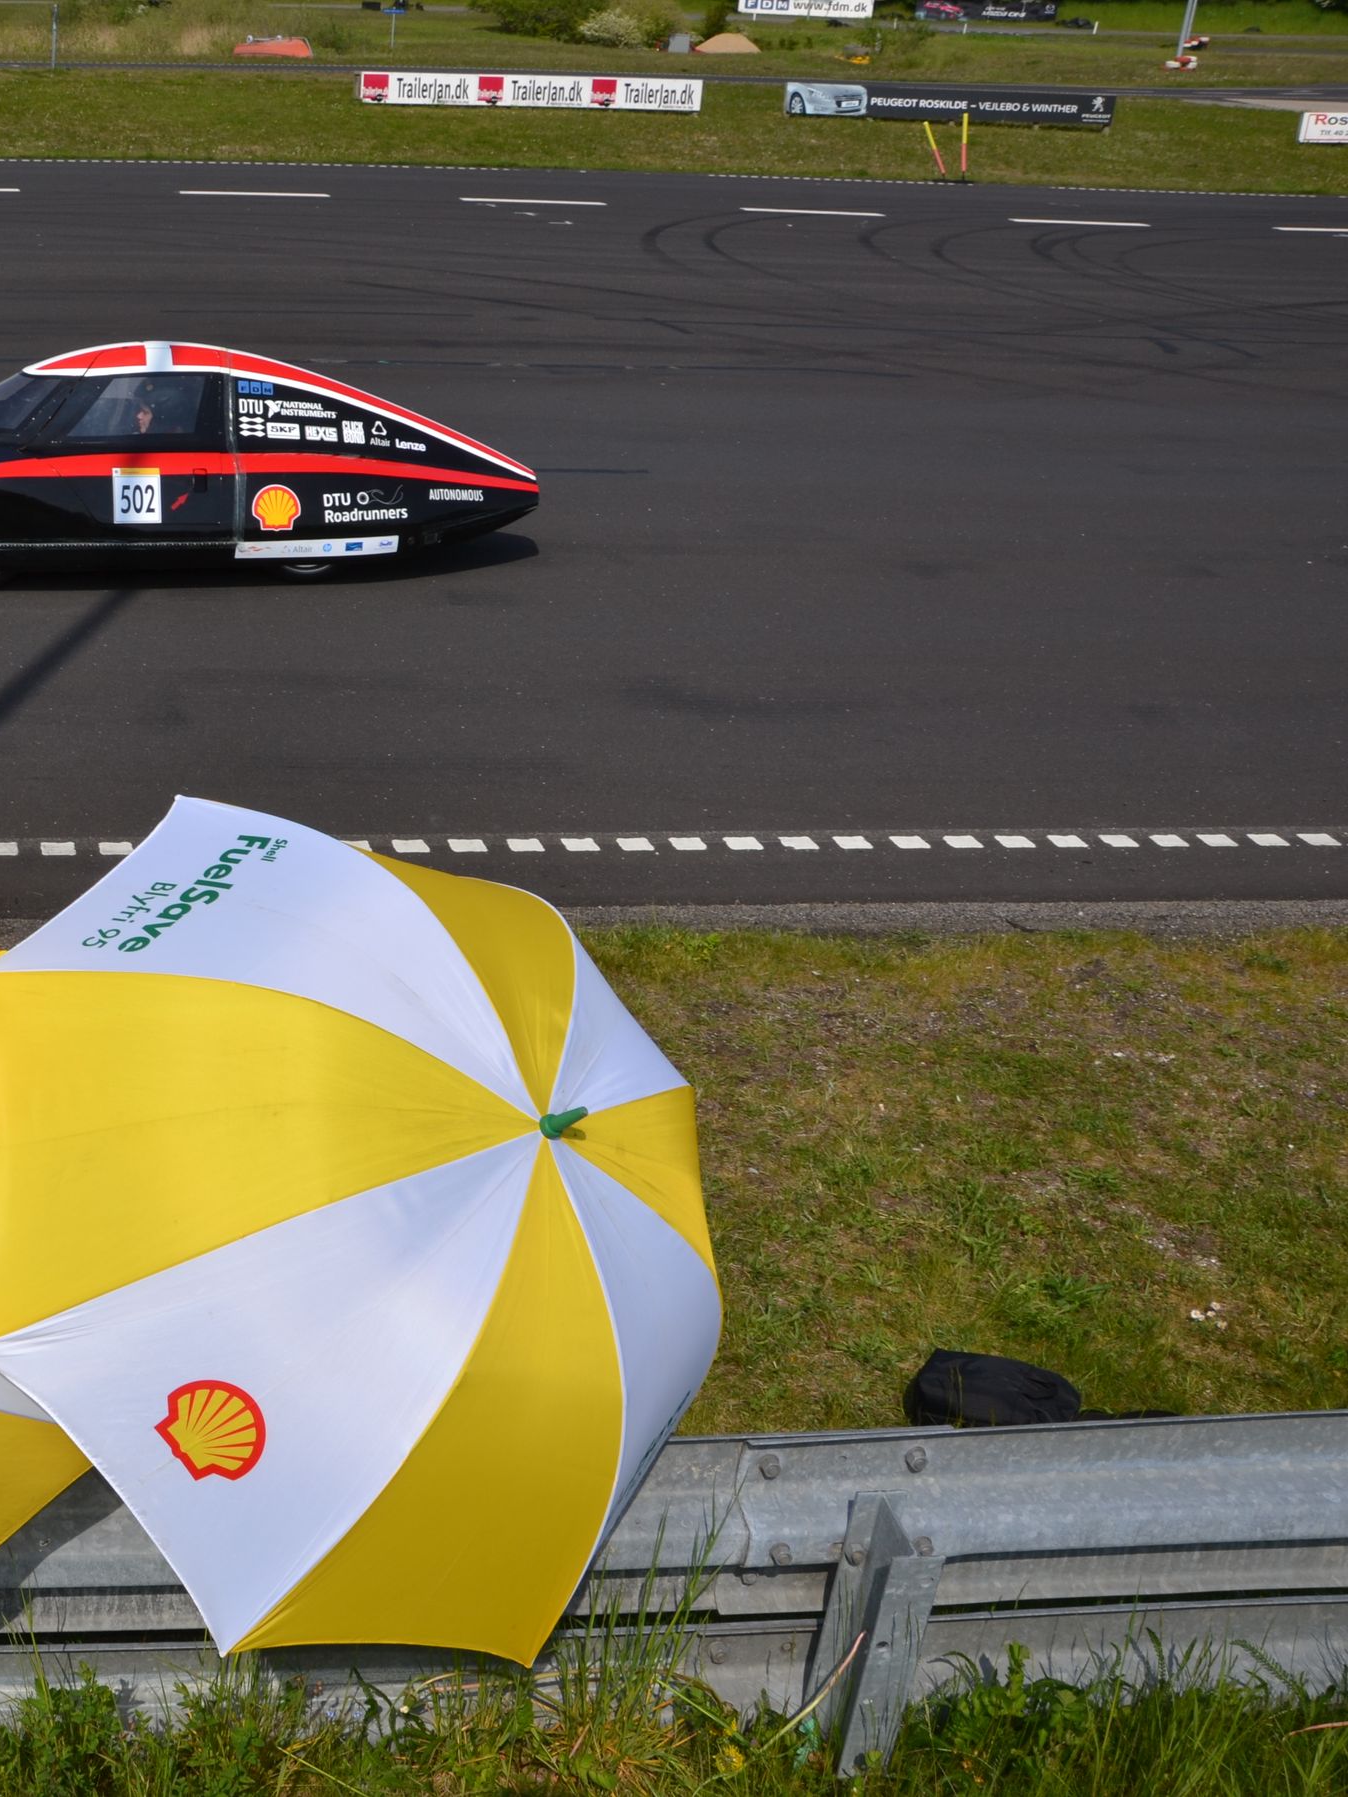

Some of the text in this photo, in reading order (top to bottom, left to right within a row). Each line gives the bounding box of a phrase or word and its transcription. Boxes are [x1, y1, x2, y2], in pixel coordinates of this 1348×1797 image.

[745, 0, 789, 10] FDM
[793, 1, 867, 13] www.fdm.dk
[396, 78, 470, 103] TrailerJan.dk
[511, 80, 583, 105] TrailerJan.dk
[624, 82, 695, 108] TrailerJan.dk
[870, 97, 918, 107] PEUGEOT
[919, 99, 968, 110] ROSKILDE
[978, 101, 1021, 112] VEJLEBO
[1022, 103, 1030, 112] &
[1031, 104, 1079, 113] WINTHER
[239, 382, 273, 395] FDM
[238, 398, 264, 415] DTU
[282, 400, 324, 411] NATIONAL
[280, 408, 337, 420] INSTRUMENTS
[305, 425, 338, 441] HEXIS
[370, 436, 391, 447] Altair
[395, 438, 427, 452] Lenze
[120, 484, 156, 514] 502
[323, 493, 351, 508] DTU
[429, 488, 484, 502] AUTONOMOUS
[324, 507, 408, 524] Roadrunners
[260, 838, 289, 863] Shell
[117, 834, 272, 953] FuelSave
[81, 881, 178, 949] Blyfri 95
